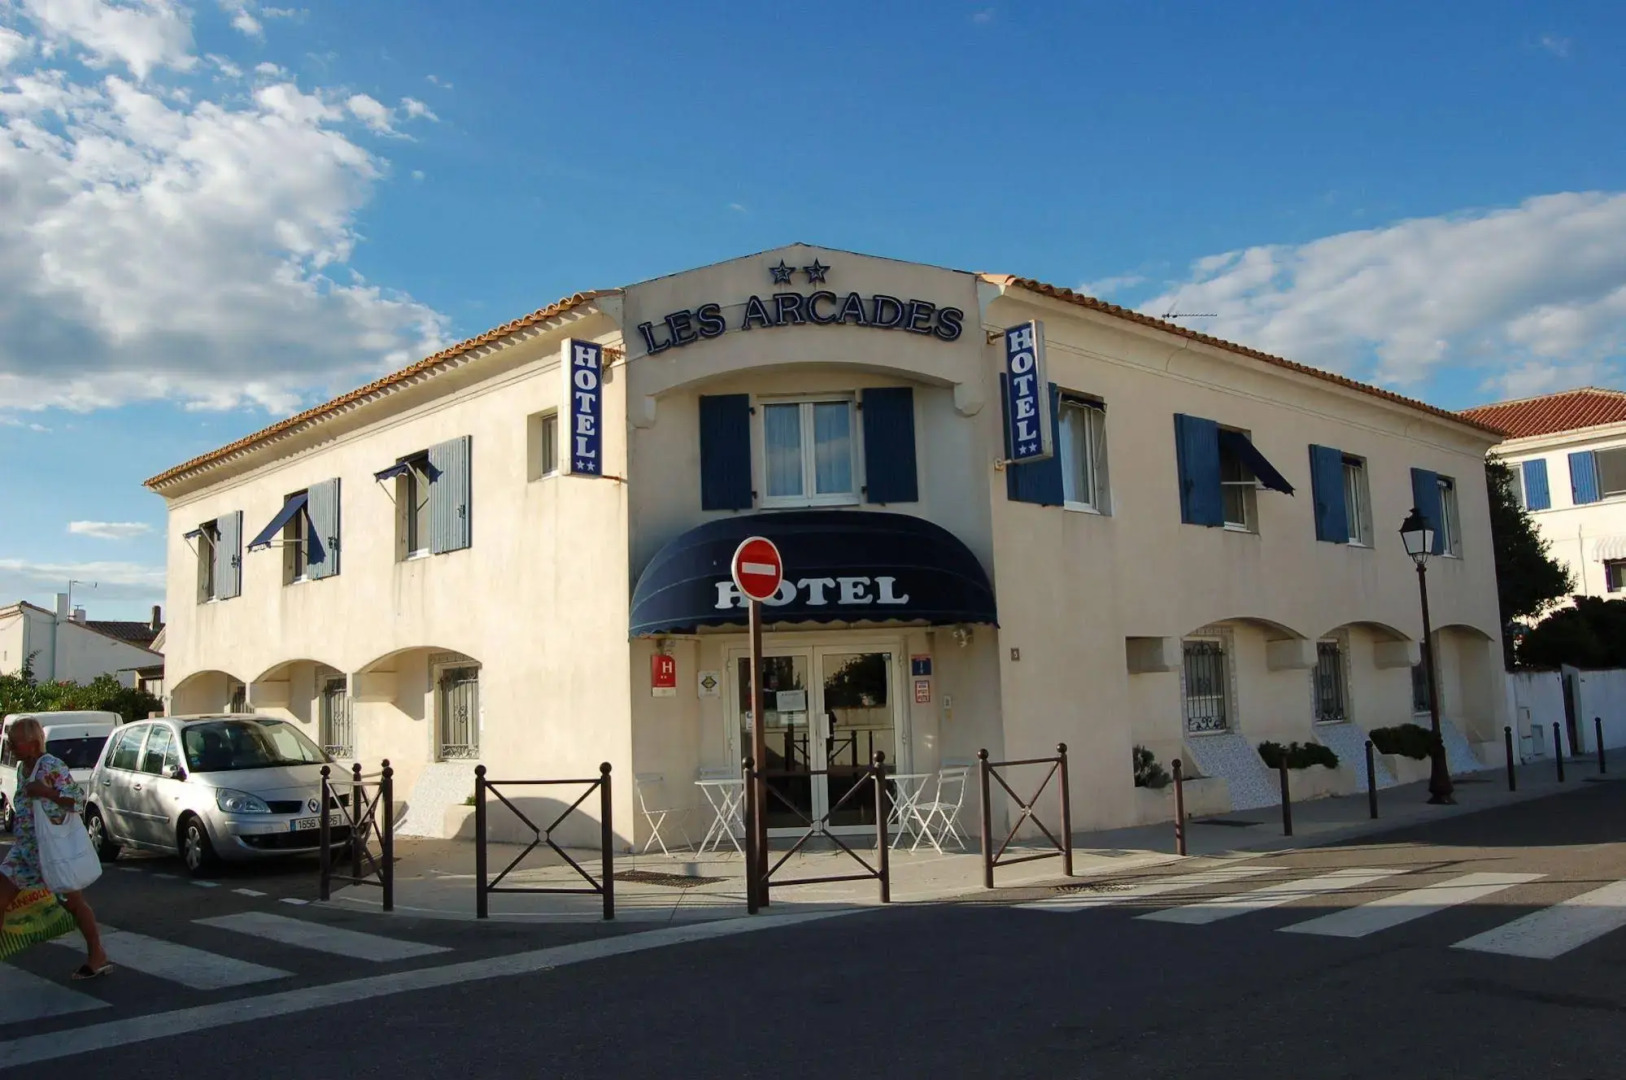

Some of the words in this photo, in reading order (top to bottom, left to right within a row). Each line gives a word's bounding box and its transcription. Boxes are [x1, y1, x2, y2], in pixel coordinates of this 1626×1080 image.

[637, 303, 725, 354] LES
[742, 291, 964, 341] ARCADES
[574, 345, 597, 458] HOTEL
[1009, 328, 1037, 441] HOTEL
[662, 661, 673, 673] H
